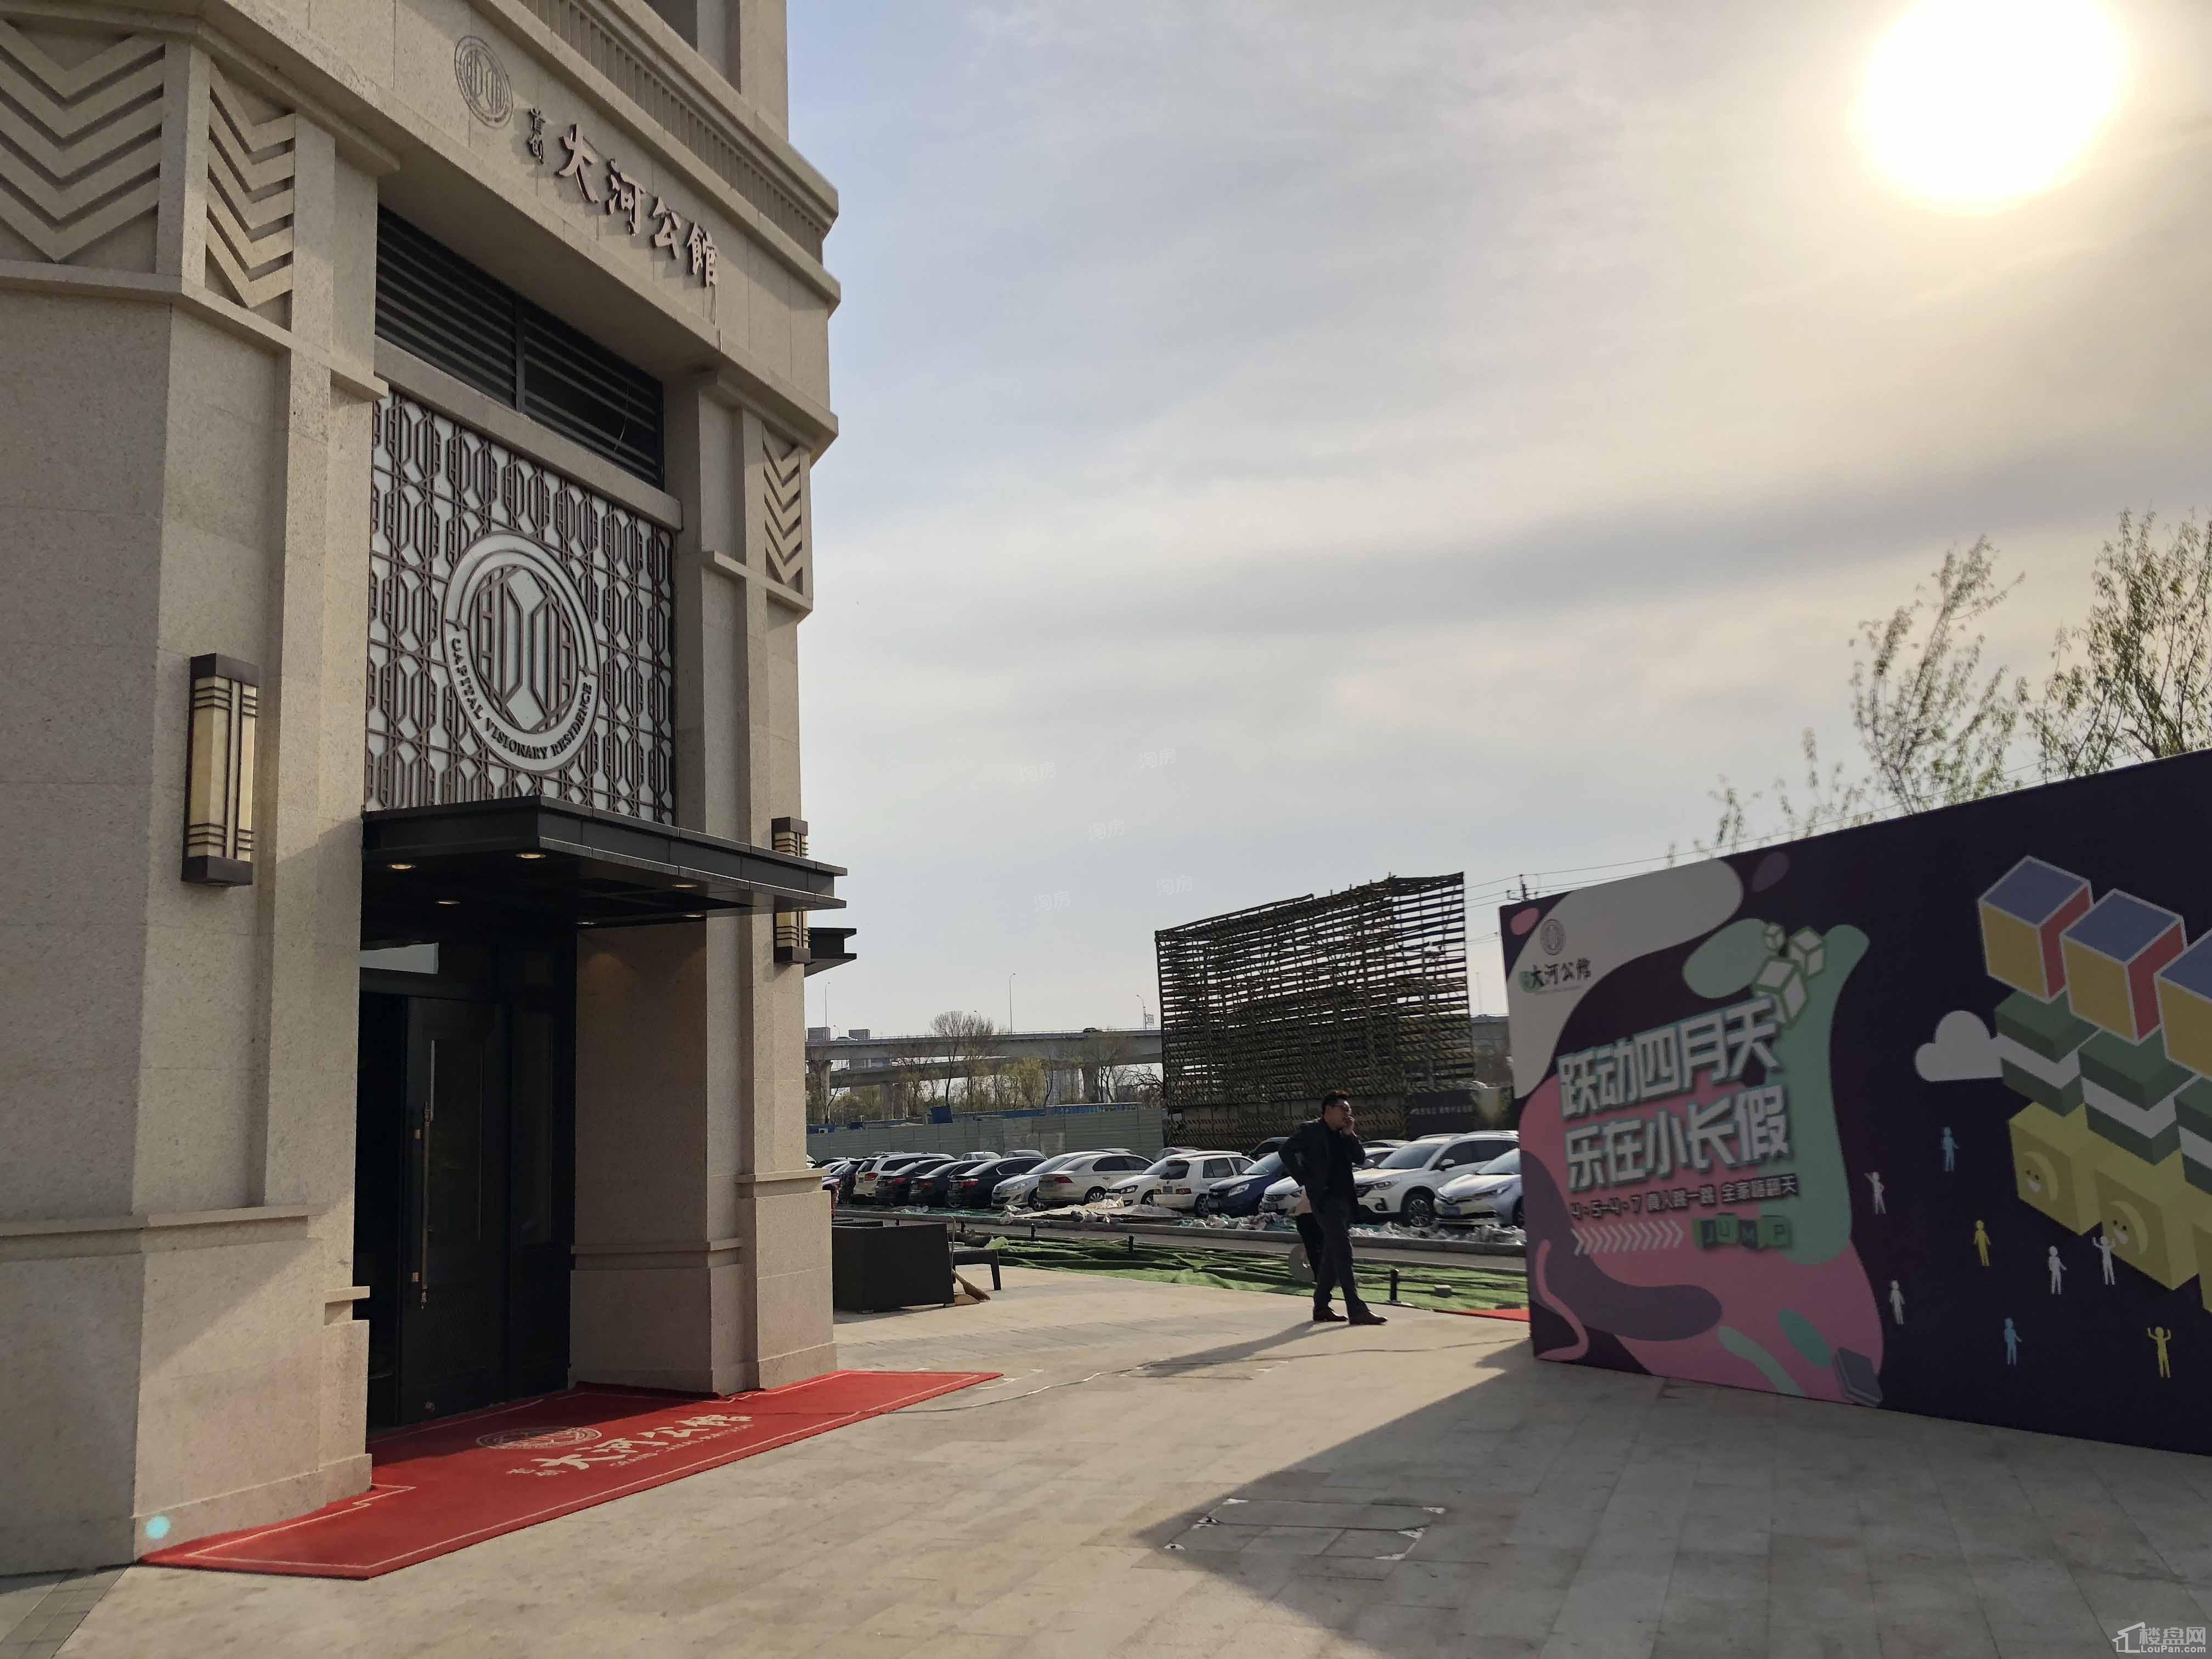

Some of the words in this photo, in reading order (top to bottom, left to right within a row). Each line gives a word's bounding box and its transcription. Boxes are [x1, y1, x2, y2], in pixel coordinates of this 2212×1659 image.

[554, 123, 718, 287] 大河公館
[450, 637, 484, 720] CAPITAL
[486, 716, 548, 760] VISIONARY
[550, 682, 593, 758] RESIDENCE
[1557, 996, 1784, 1118] 跃动四月天
[1564, 1084, 1791, 1192] 乐在小长假
